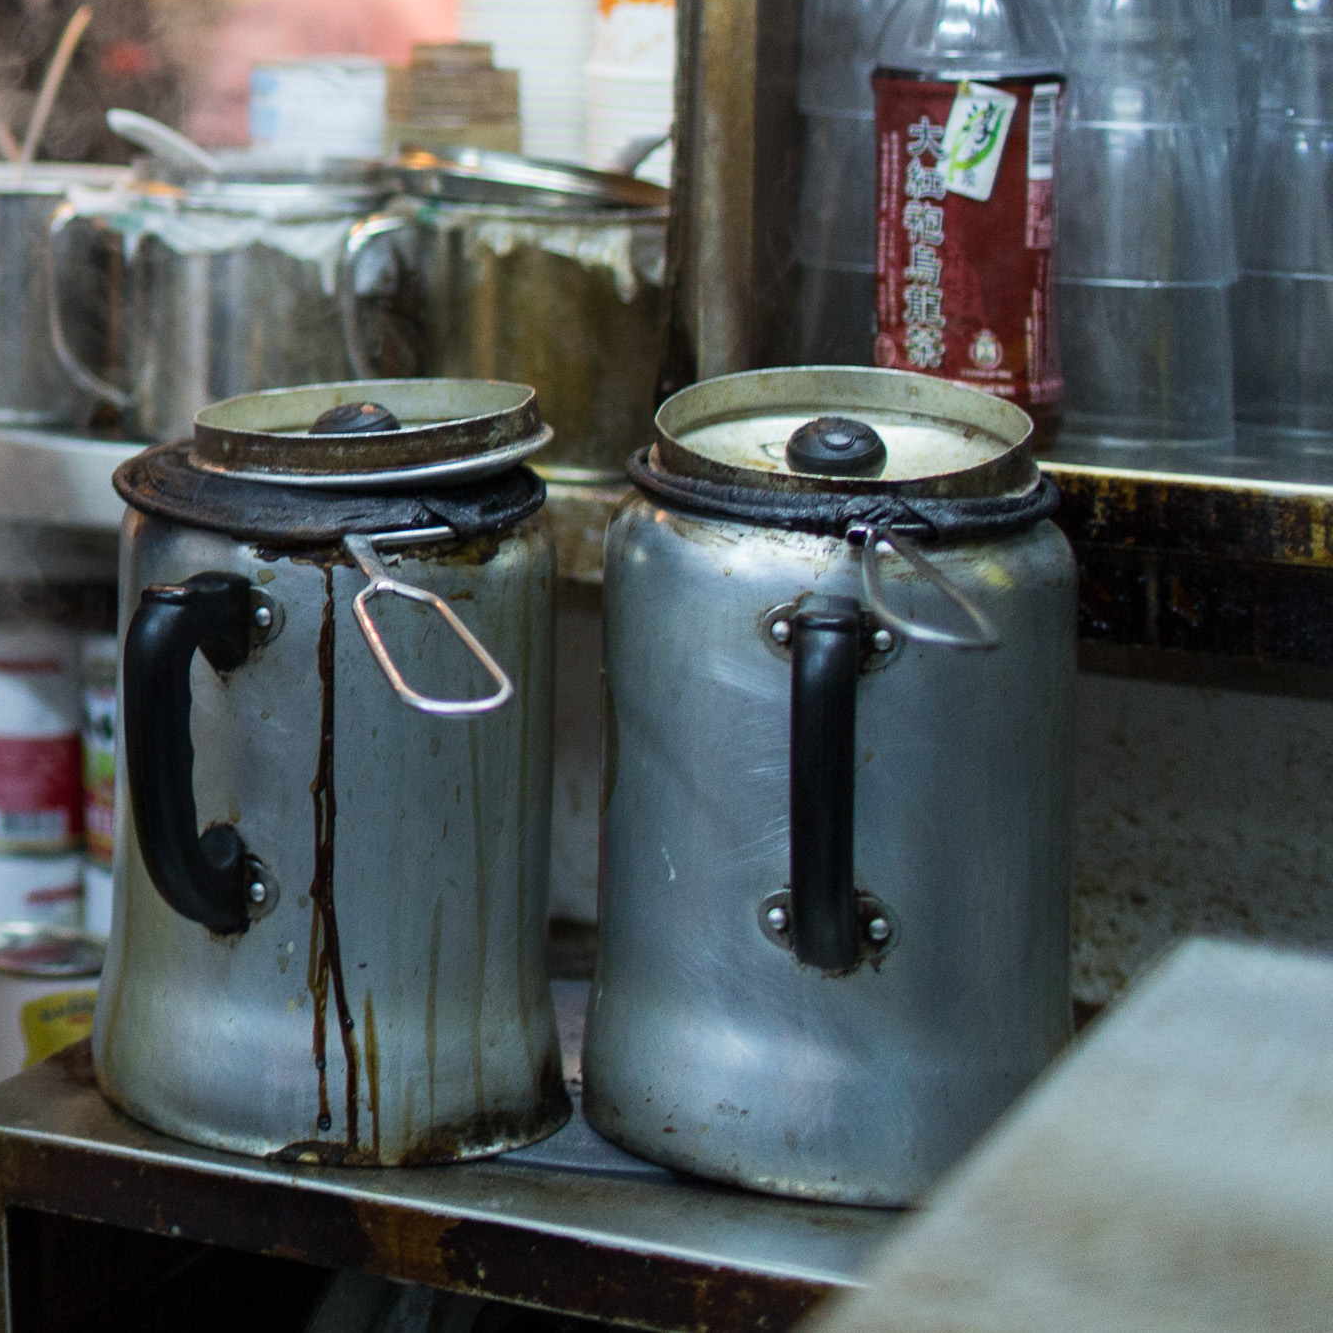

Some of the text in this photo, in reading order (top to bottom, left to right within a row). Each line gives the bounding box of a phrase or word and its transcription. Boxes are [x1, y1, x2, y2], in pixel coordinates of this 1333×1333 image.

[902, 115, 947, 368] 大紅袍烏龍茶
